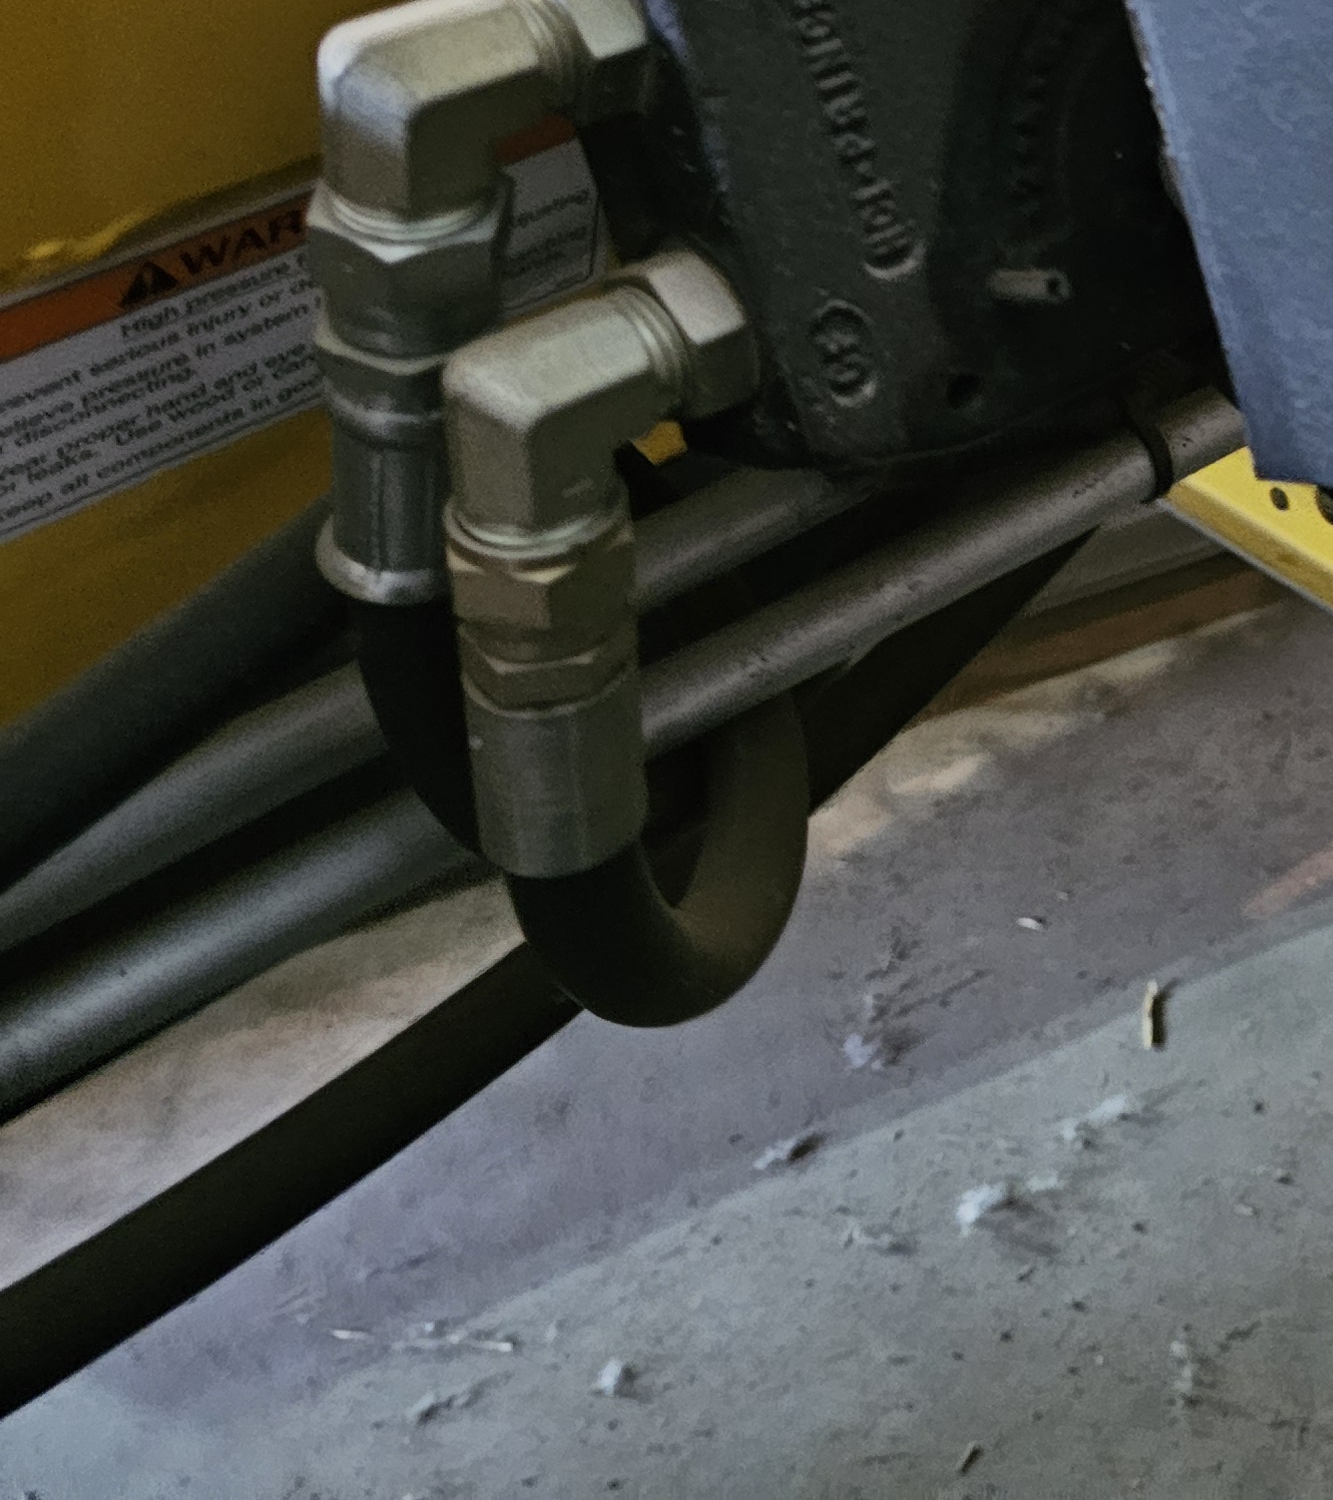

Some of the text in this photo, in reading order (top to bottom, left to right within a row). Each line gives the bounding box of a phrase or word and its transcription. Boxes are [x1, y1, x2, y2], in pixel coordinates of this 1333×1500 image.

[89, 330, 180, 377] serious
[185, 301, 252, 337] injury
[258, 287, 286, 309] or
[121, 304, 179, 338] High
[185, 262, 291, 315] pressure
[57, 414, 141, 462] proper
[146, 381, 207, 418] hand
[214, 362, 258, 391] and
[264, 343, 306, 371] eye
[81, 353, 190, 414] pressure
[196, 340, 216, 361] in
[224, 303, 309, 346] system
[60, 471, 90, 496] all
[96, 408, 244, 479] components
[250, 394, 272, 412] in
[116, 418, 164, 446] Use
[242, 374, 262, 393] or
